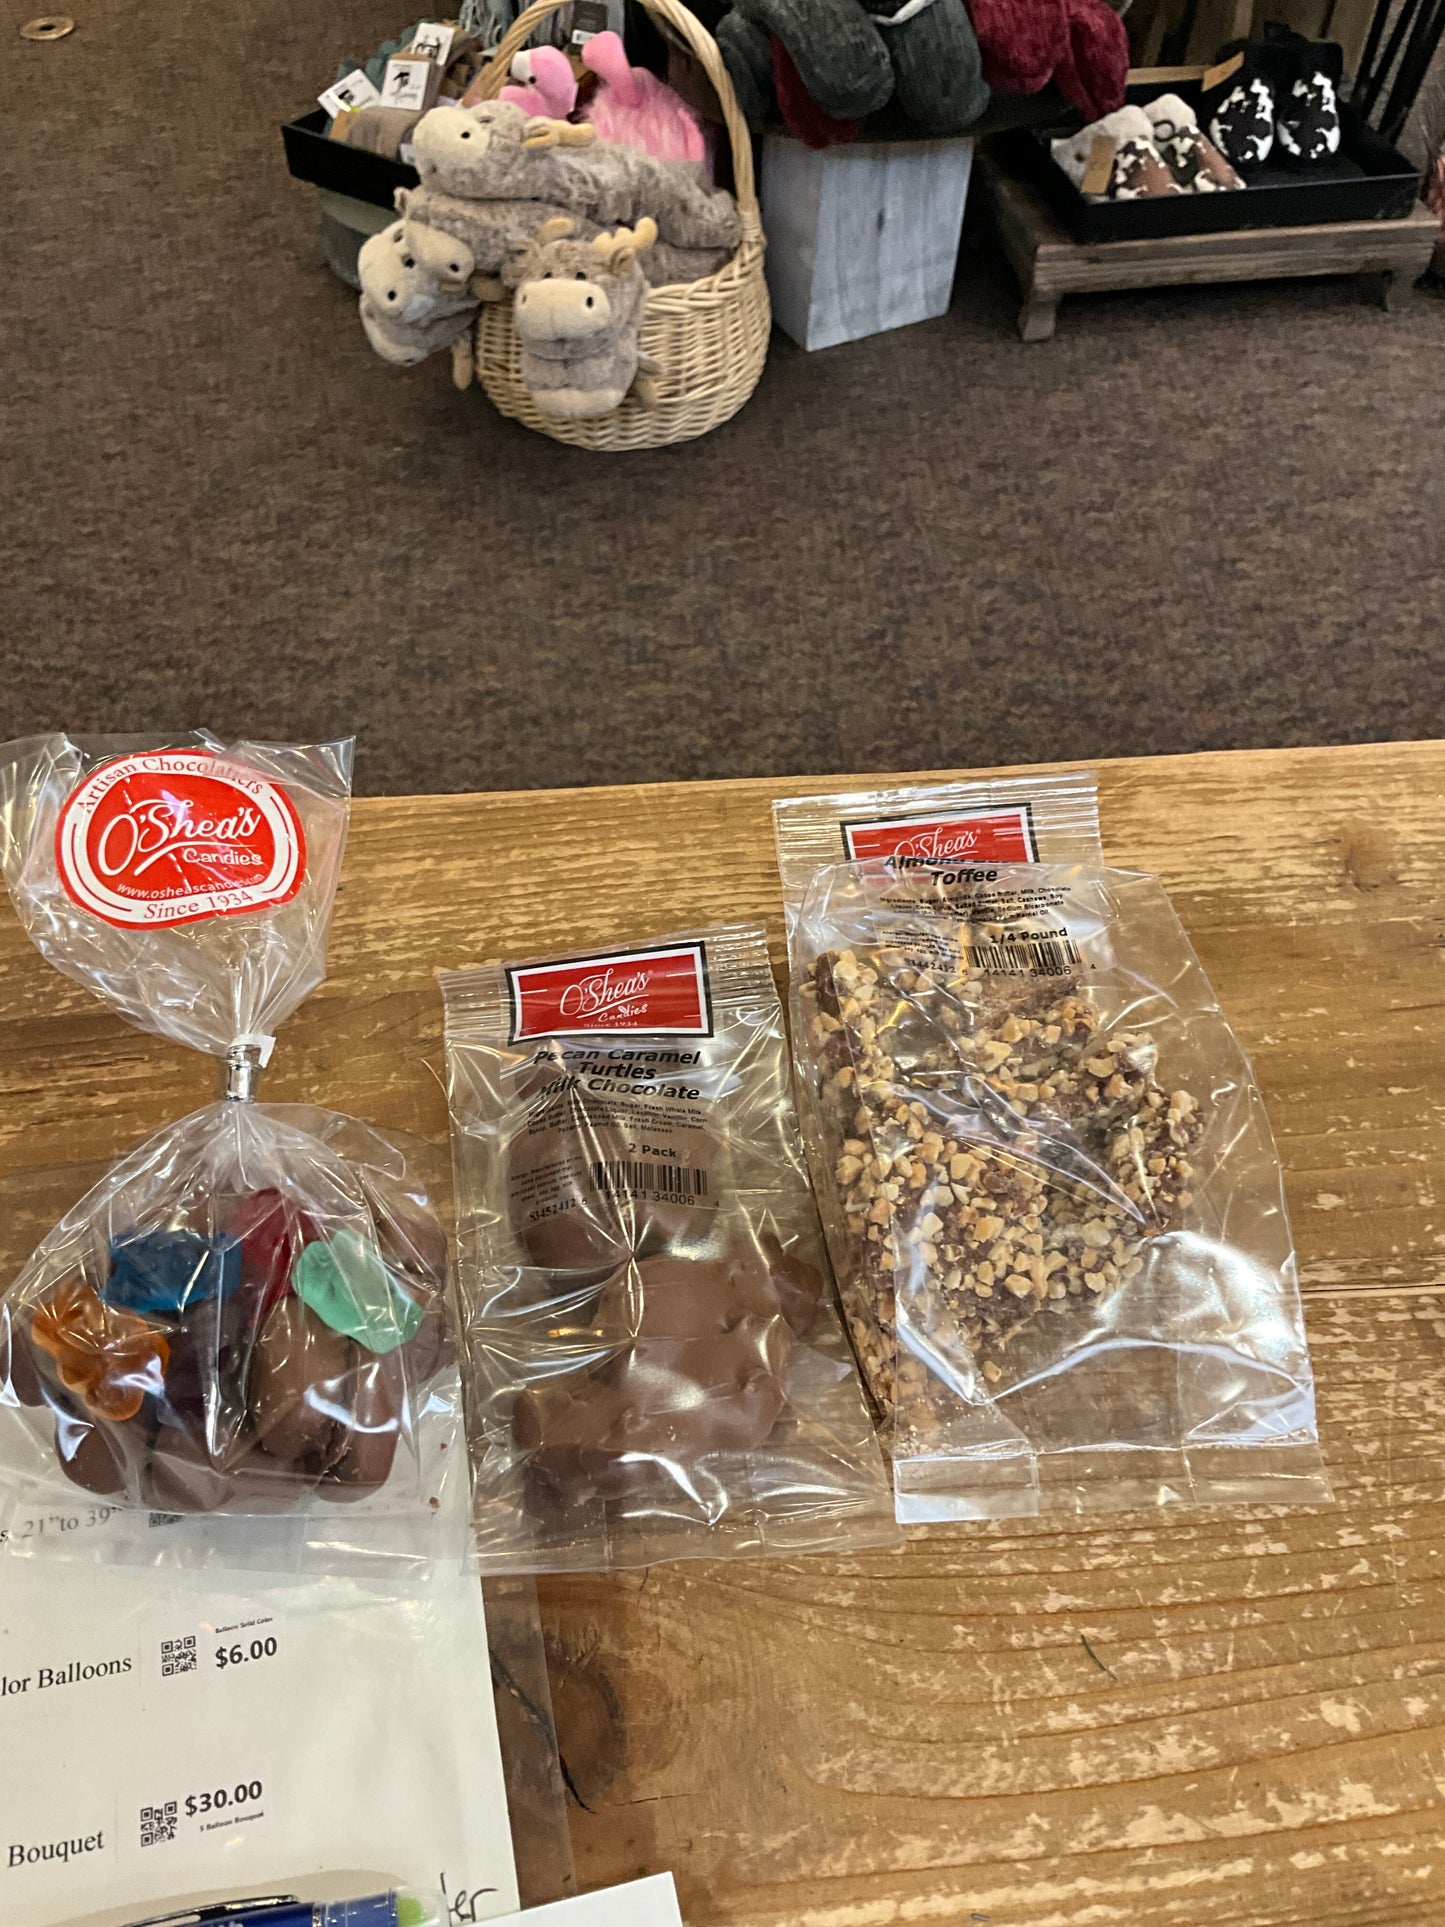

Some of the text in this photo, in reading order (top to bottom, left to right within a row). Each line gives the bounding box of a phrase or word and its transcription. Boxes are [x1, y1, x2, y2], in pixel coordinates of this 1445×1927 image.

[77, 762, 138, 814] Artisan
[98, 800, 262, 876] O'Shea's
[183, 848, 264, 866] Candies
[931, 868, 998, 886] Toffee
[144, 891, 254, 919] Since 1934
[989, 927, 1069, 945] 1/4 Pound
[984, 967, 1026, 978] 14141
[1030, 966, 1072, 978] 34006
[560, 968, 650, 1016] O'Shea's
[534, 1049, 702, 1065] Pecan Caramel
[579, 1061, 657, 1080] Turtles
[588, 1078, 700, 1101] Chocolate
[628, 1143, 678, 1158] 2 Pack
[653, 1190, 696, 1205] 34006
[215, 1636, 279, 1669] $6.00
[0, 1658, 133, 1697] lor Balloons
[184, 1780, 263, 1818] $30.00
[234, 1811, 265, 1824] Bouquet
[7, 1830, 105, 1867] Bouquet
